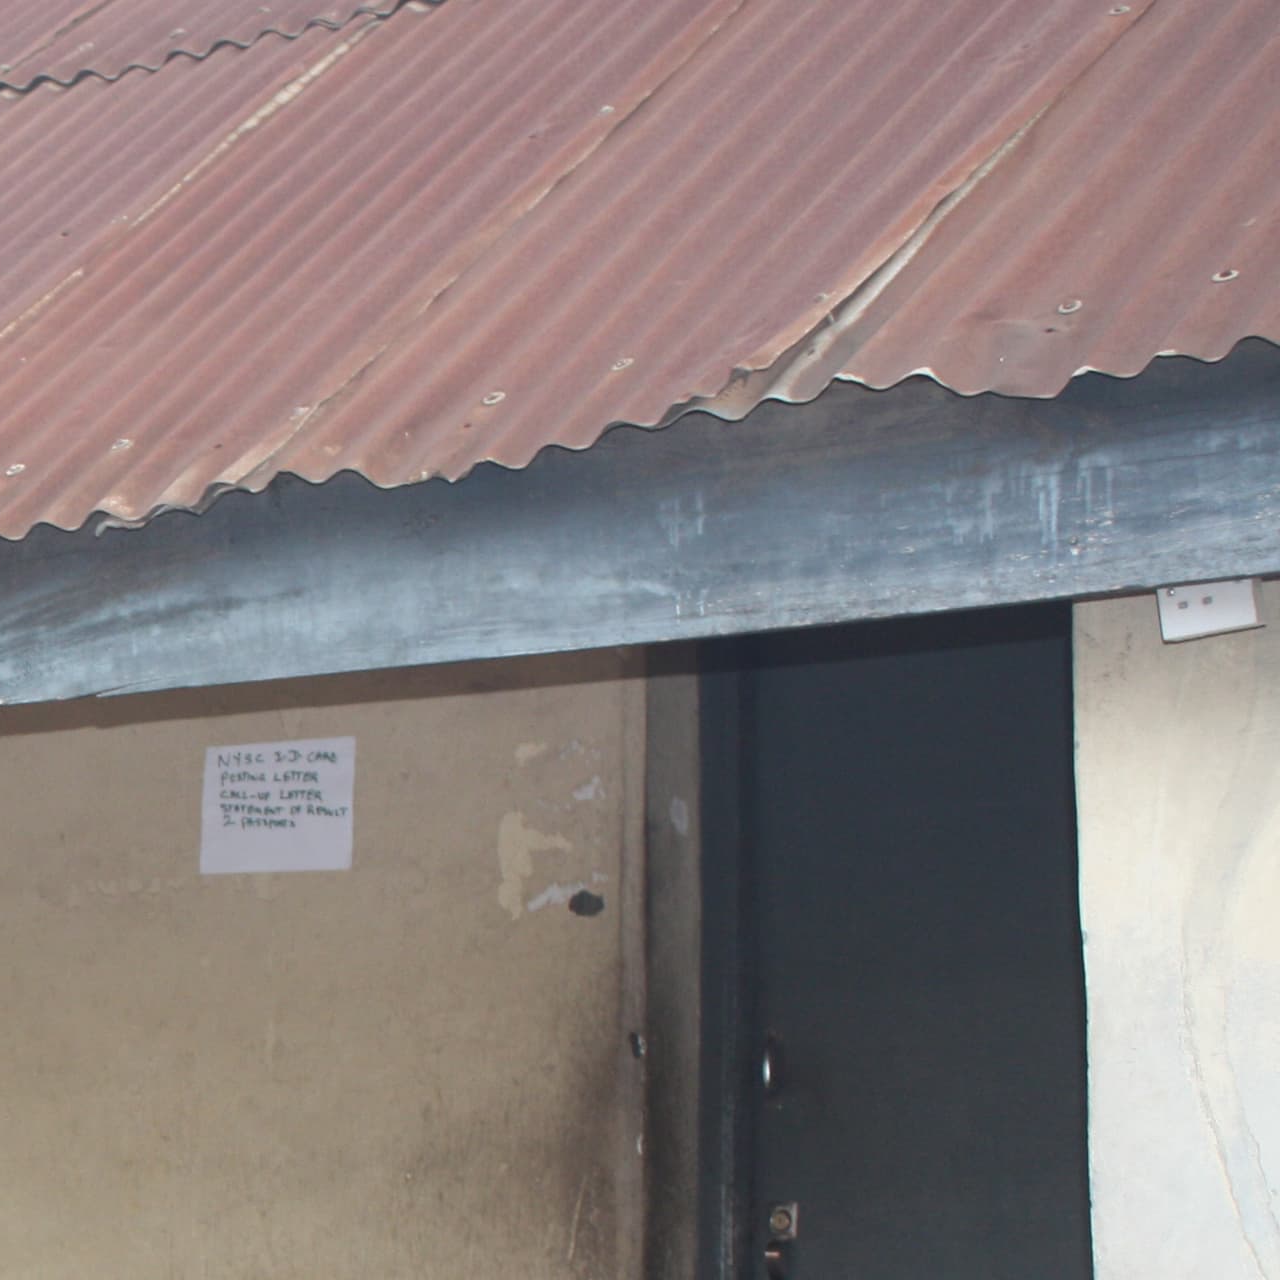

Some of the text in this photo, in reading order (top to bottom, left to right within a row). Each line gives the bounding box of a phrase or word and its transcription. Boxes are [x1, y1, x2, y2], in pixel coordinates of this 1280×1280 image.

[273, 770, 319, 783] LETTER
[280, 789, 322, 801] LETTER
[223, 814, 236, 827] 2
